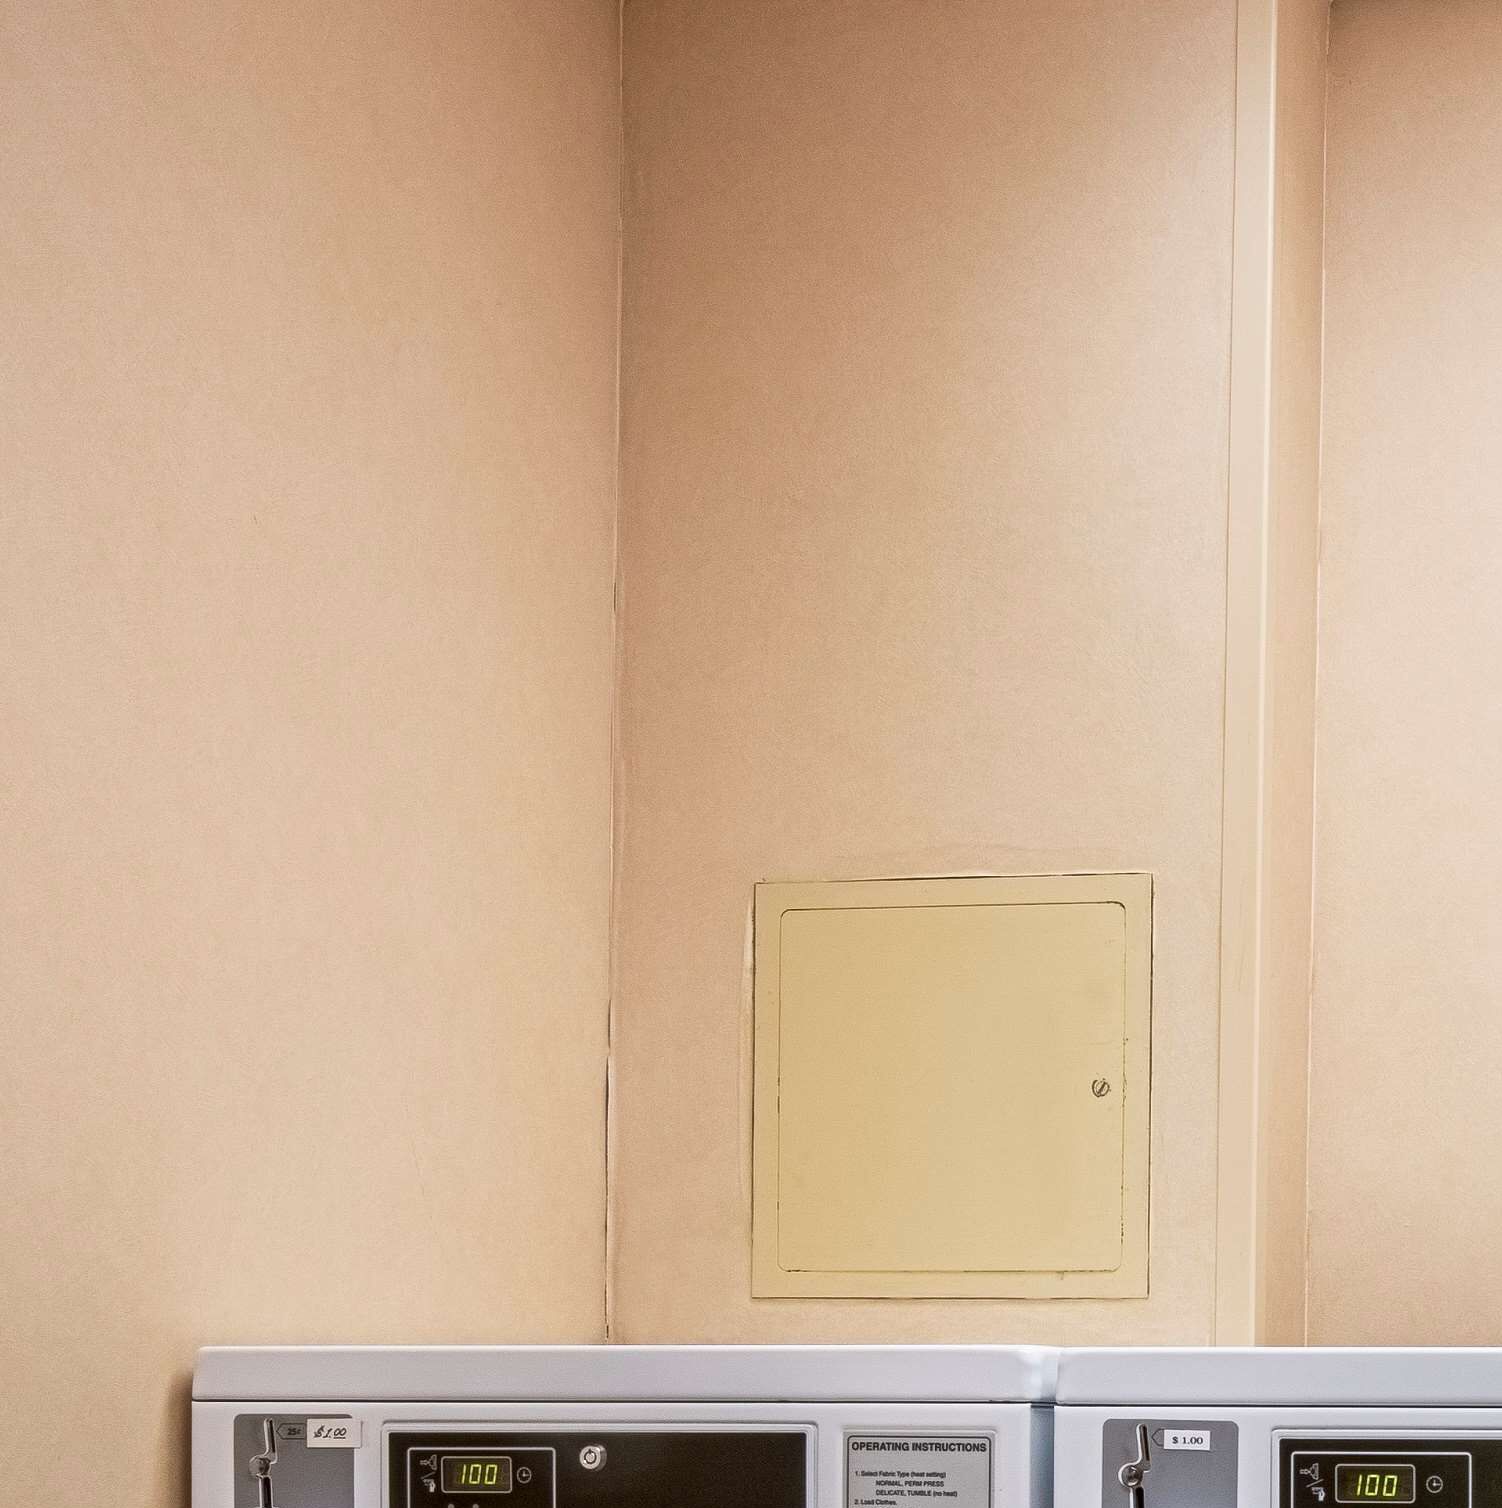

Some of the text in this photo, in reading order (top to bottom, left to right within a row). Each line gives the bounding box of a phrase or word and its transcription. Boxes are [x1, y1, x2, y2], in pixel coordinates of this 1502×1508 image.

[852, 1442, 986, 1452] OPERATING INSTRUCTIONS
[1172, 1436, 1178, 1444] $
[462, 1464, 498, 1484] 100
[1357, 1475, 1397, 1496] 100
